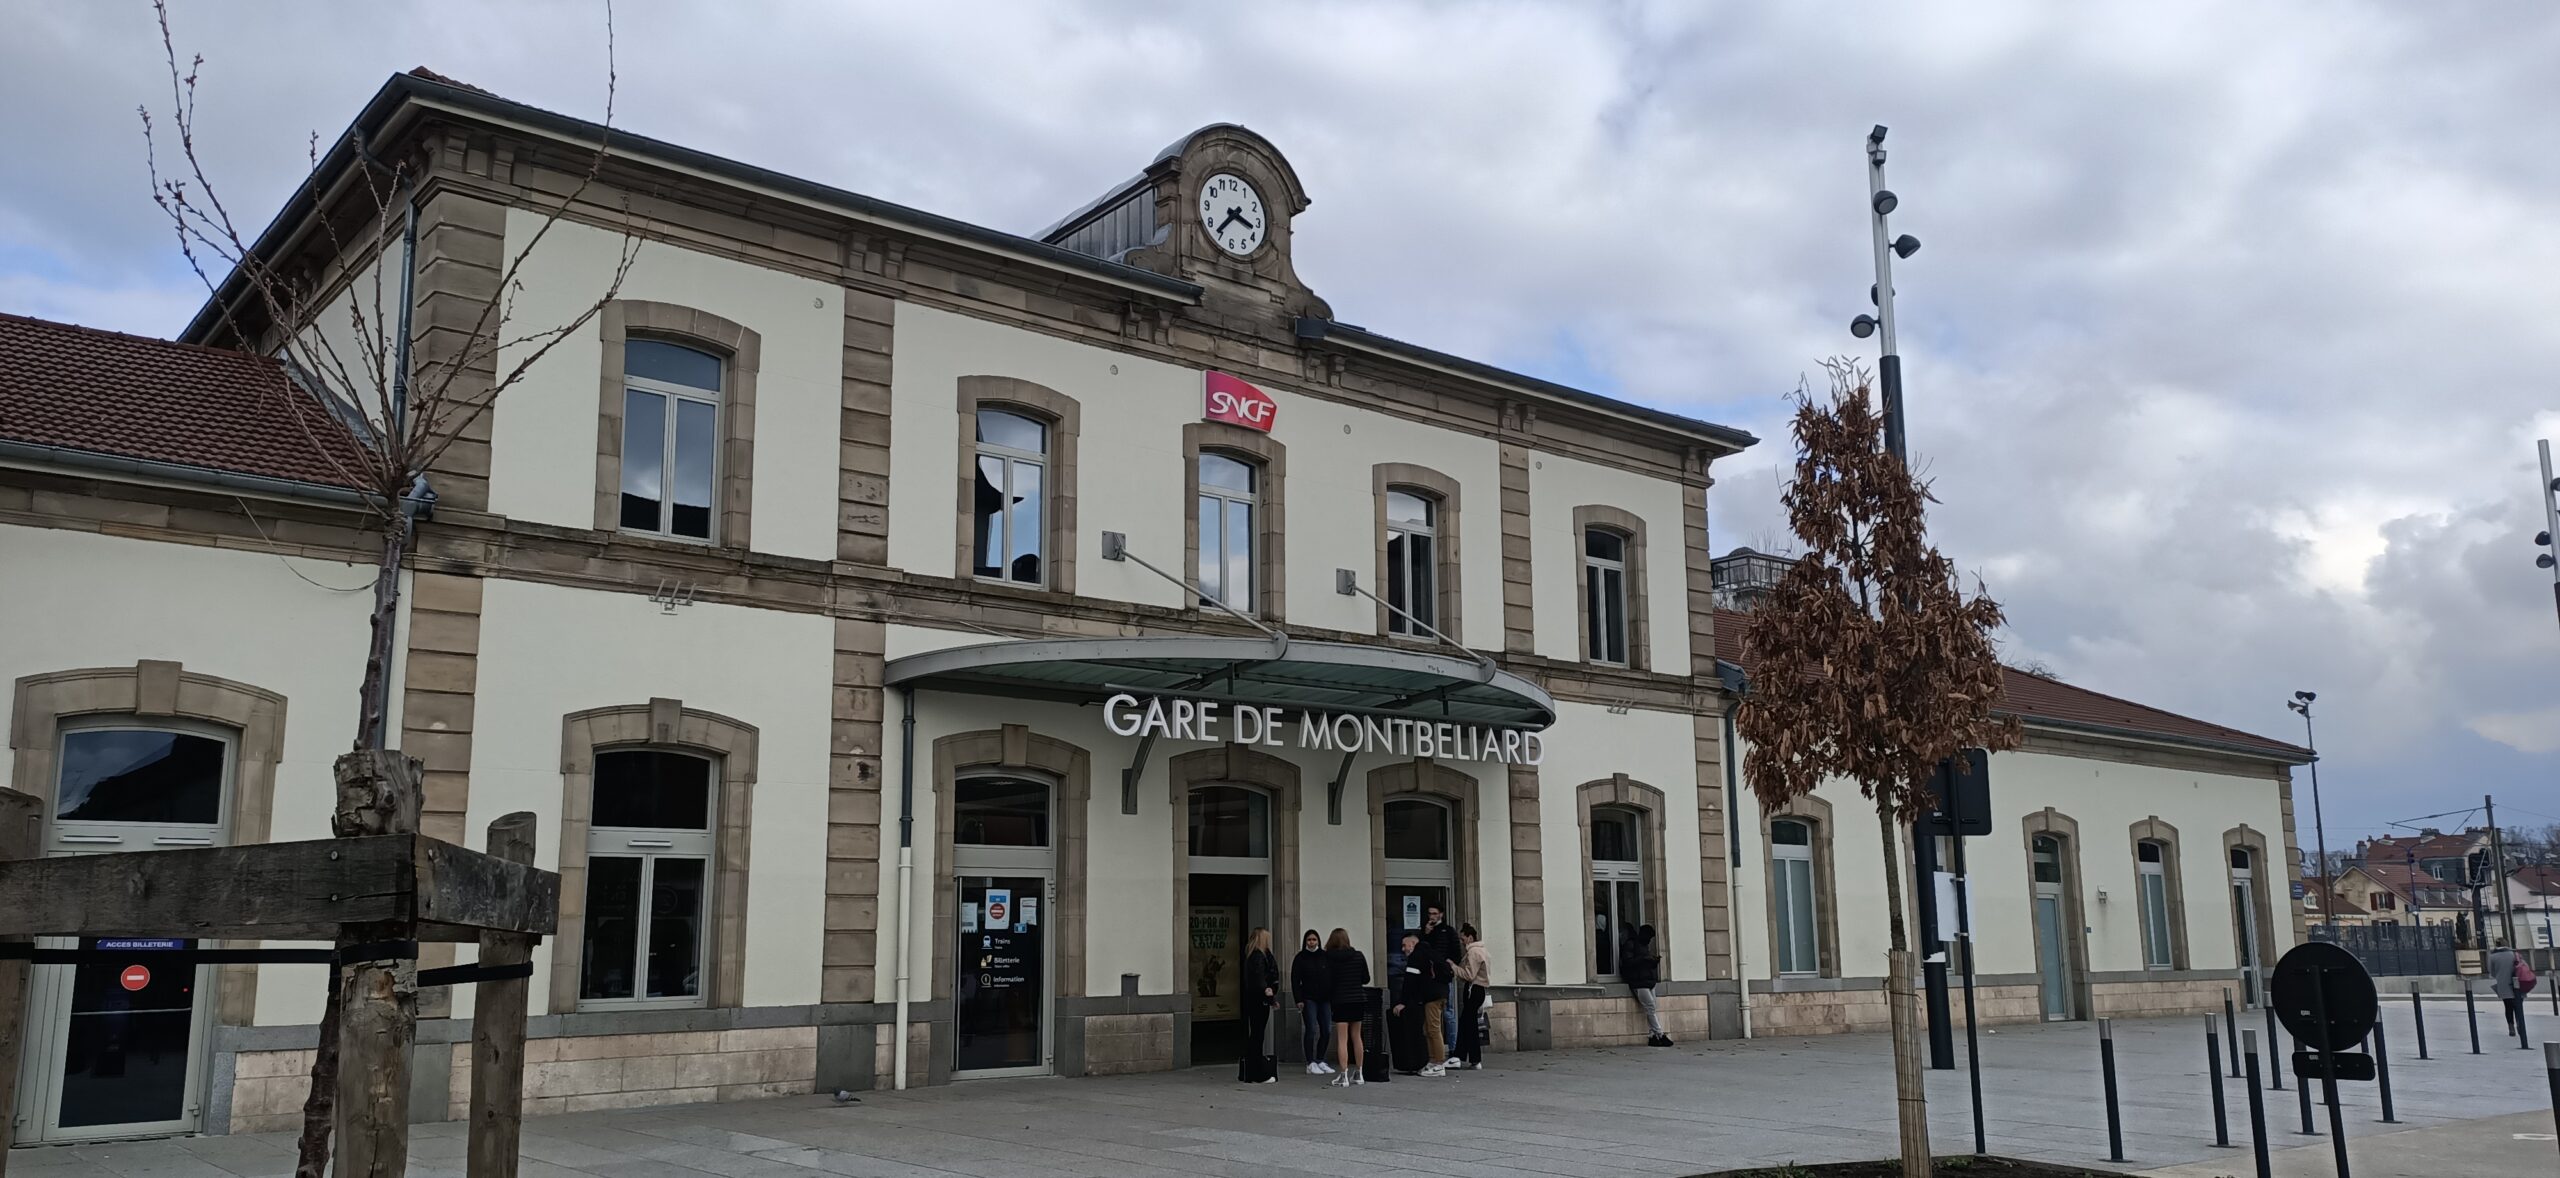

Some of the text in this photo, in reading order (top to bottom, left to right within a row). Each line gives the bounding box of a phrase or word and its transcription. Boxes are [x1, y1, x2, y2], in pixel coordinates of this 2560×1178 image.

[1219, 178, 1225, 191] 11
[1229, 179, 1238, 192] 12
[1209, 186, 1218, 198] 10
[1243, 187, 1247, 199] 1
[1204, 200, 1210, 211] 9
[1252, 201, 1257, 213] 2
[1208, 217, 1213, 228] 8
[1255, 217, 1261, 228] 3
[1250, 232, 1256, 242] 4
[1229, 238, 1235, 249] 6
[1241, 238, 1246, 249] 5
[1209, 391, 1274, 423] SNCF
[1103, 693, 1545, 766] GARE DE MONTBELIARD
